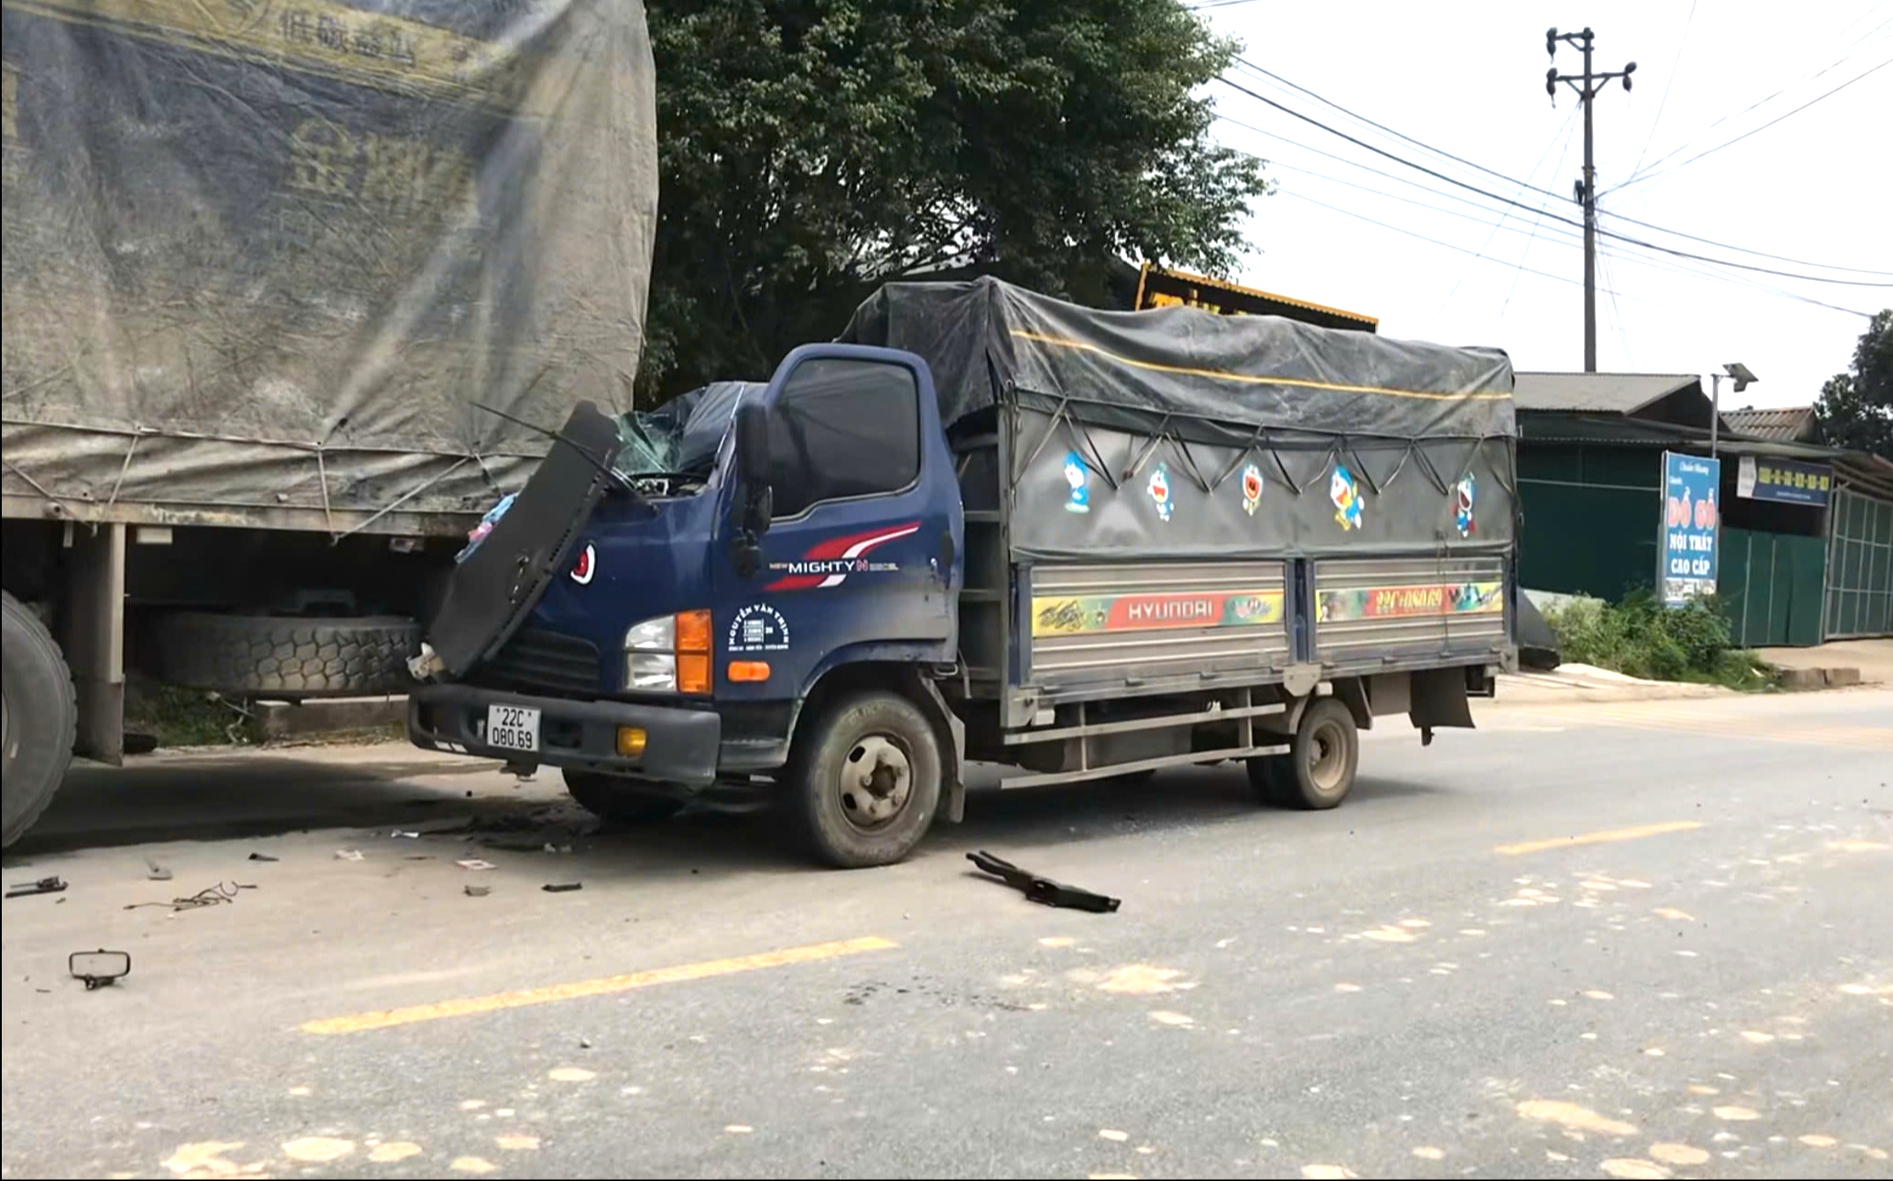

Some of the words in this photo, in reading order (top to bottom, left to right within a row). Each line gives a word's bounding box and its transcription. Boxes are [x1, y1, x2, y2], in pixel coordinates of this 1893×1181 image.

[1669, 530, 1687, 553] NỘI
[789, 561, 855, 573] MIGHTY
[1671, 558, 1690, 575] CAO
[1692, 555, 1710, 575] CẤP
[1129, 600, 1212, 619] HYUNDAI
[502, 708, 524, 727] 22C
[493, 727, 532, 749] 080.69
